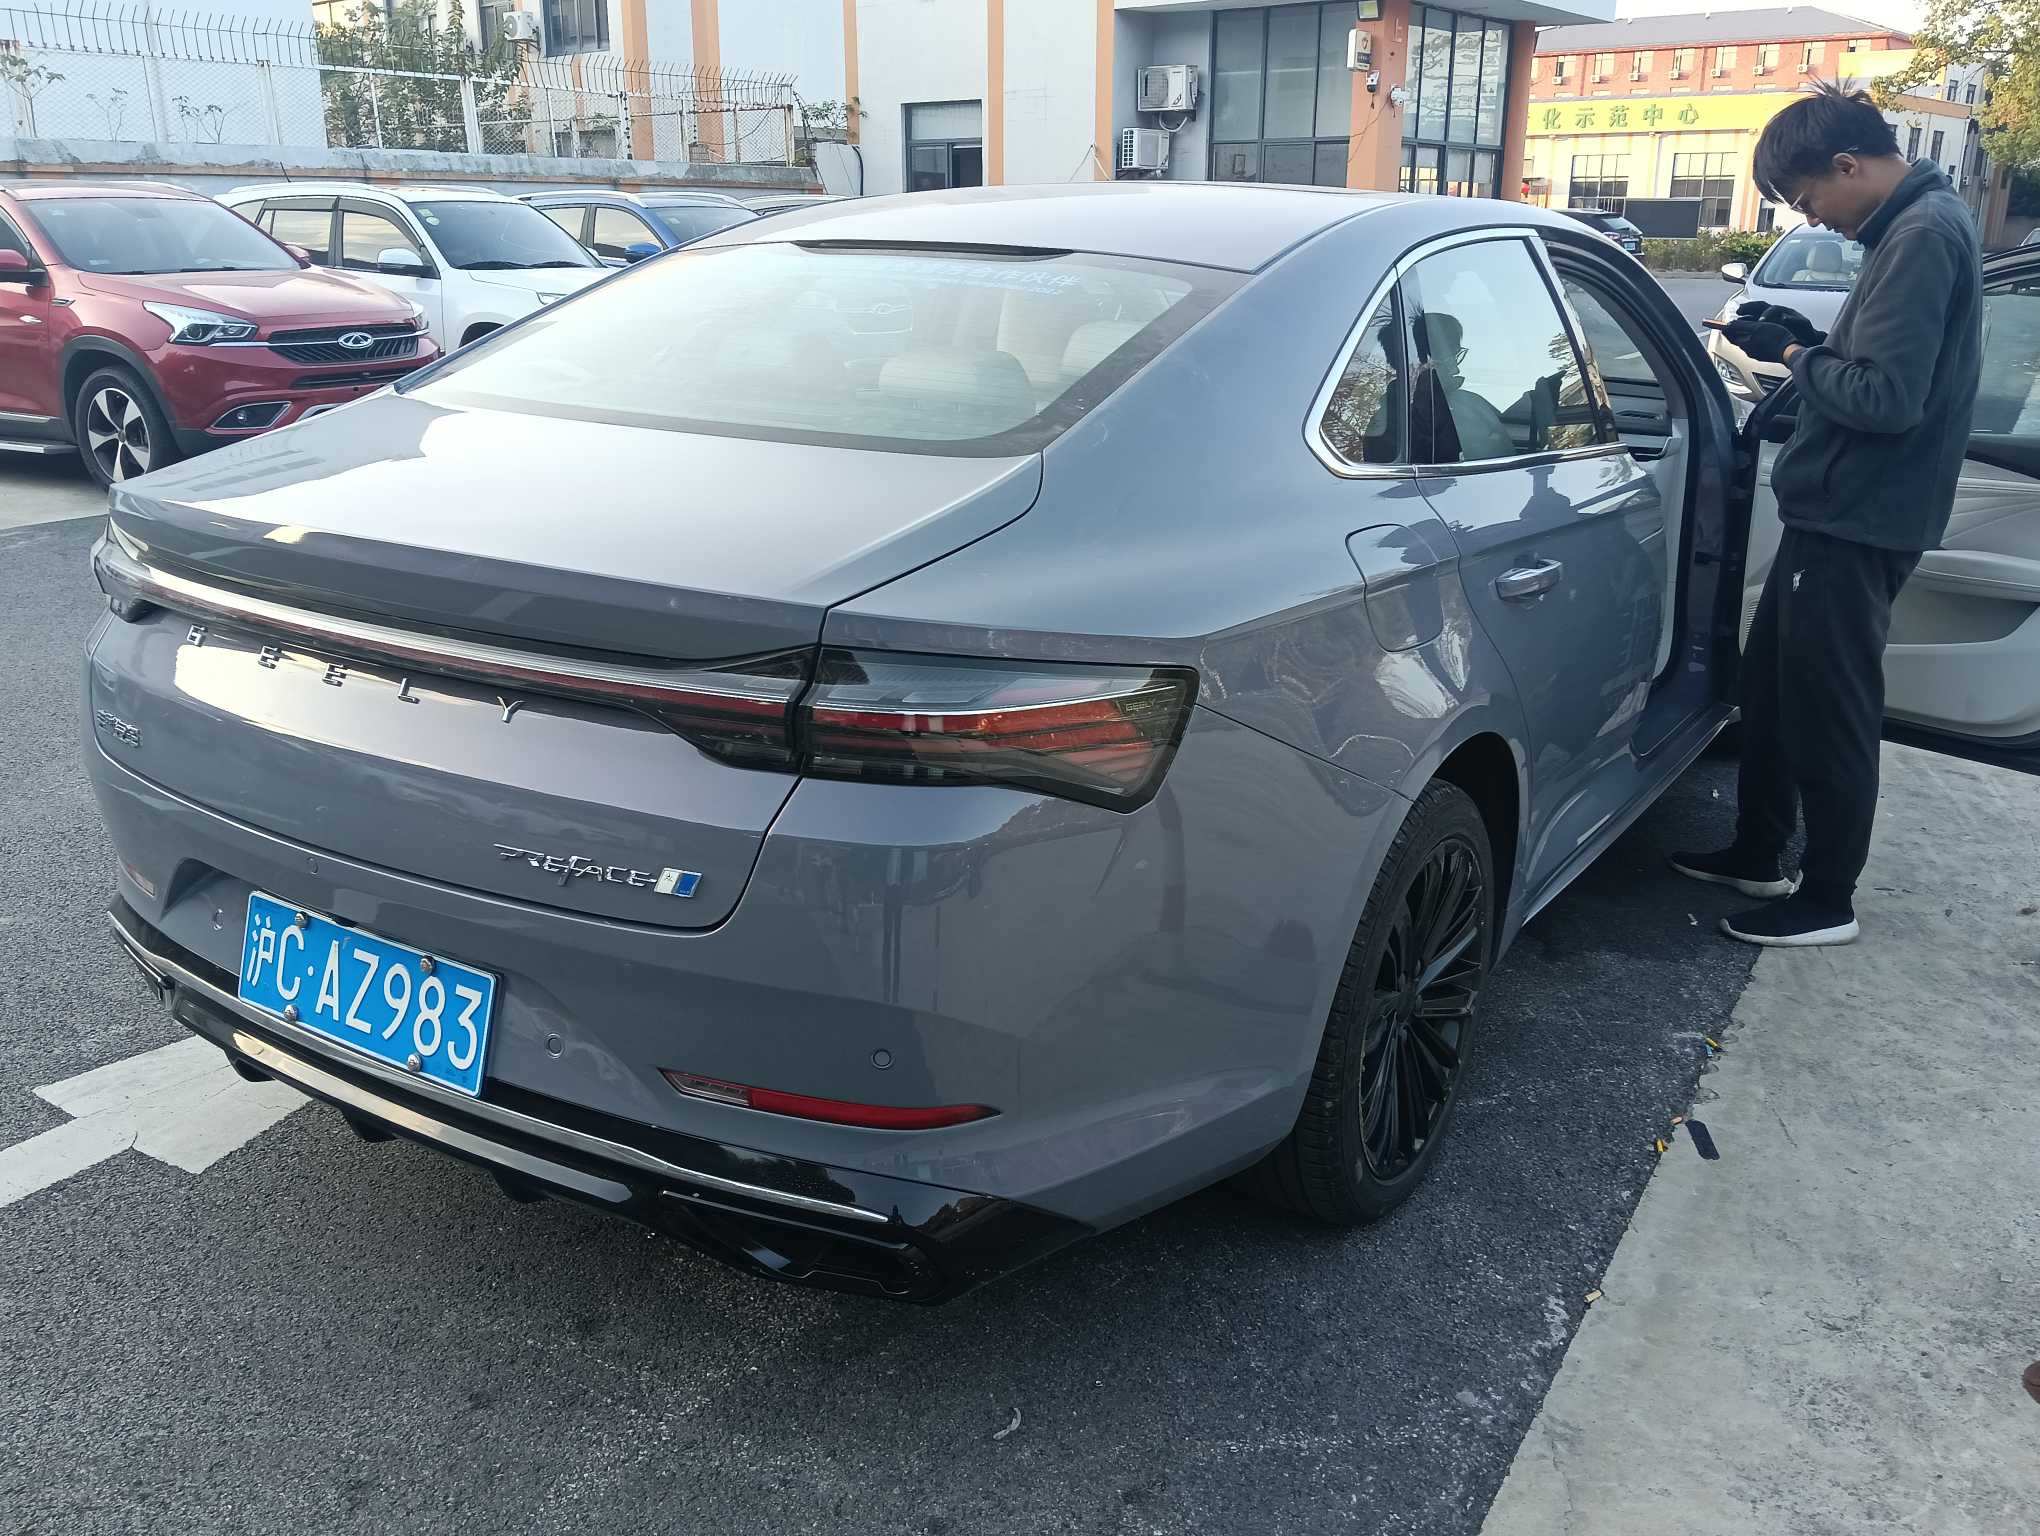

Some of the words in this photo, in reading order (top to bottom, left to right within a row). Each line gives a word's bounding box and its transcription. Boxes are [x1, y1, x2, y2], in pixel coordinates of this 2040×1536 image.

[1542, 103, 1699, 130] 化示范中心
[187, 624, 525, 724] GEELY
[246, 912, 483, 1070] 沪C·AZ983
